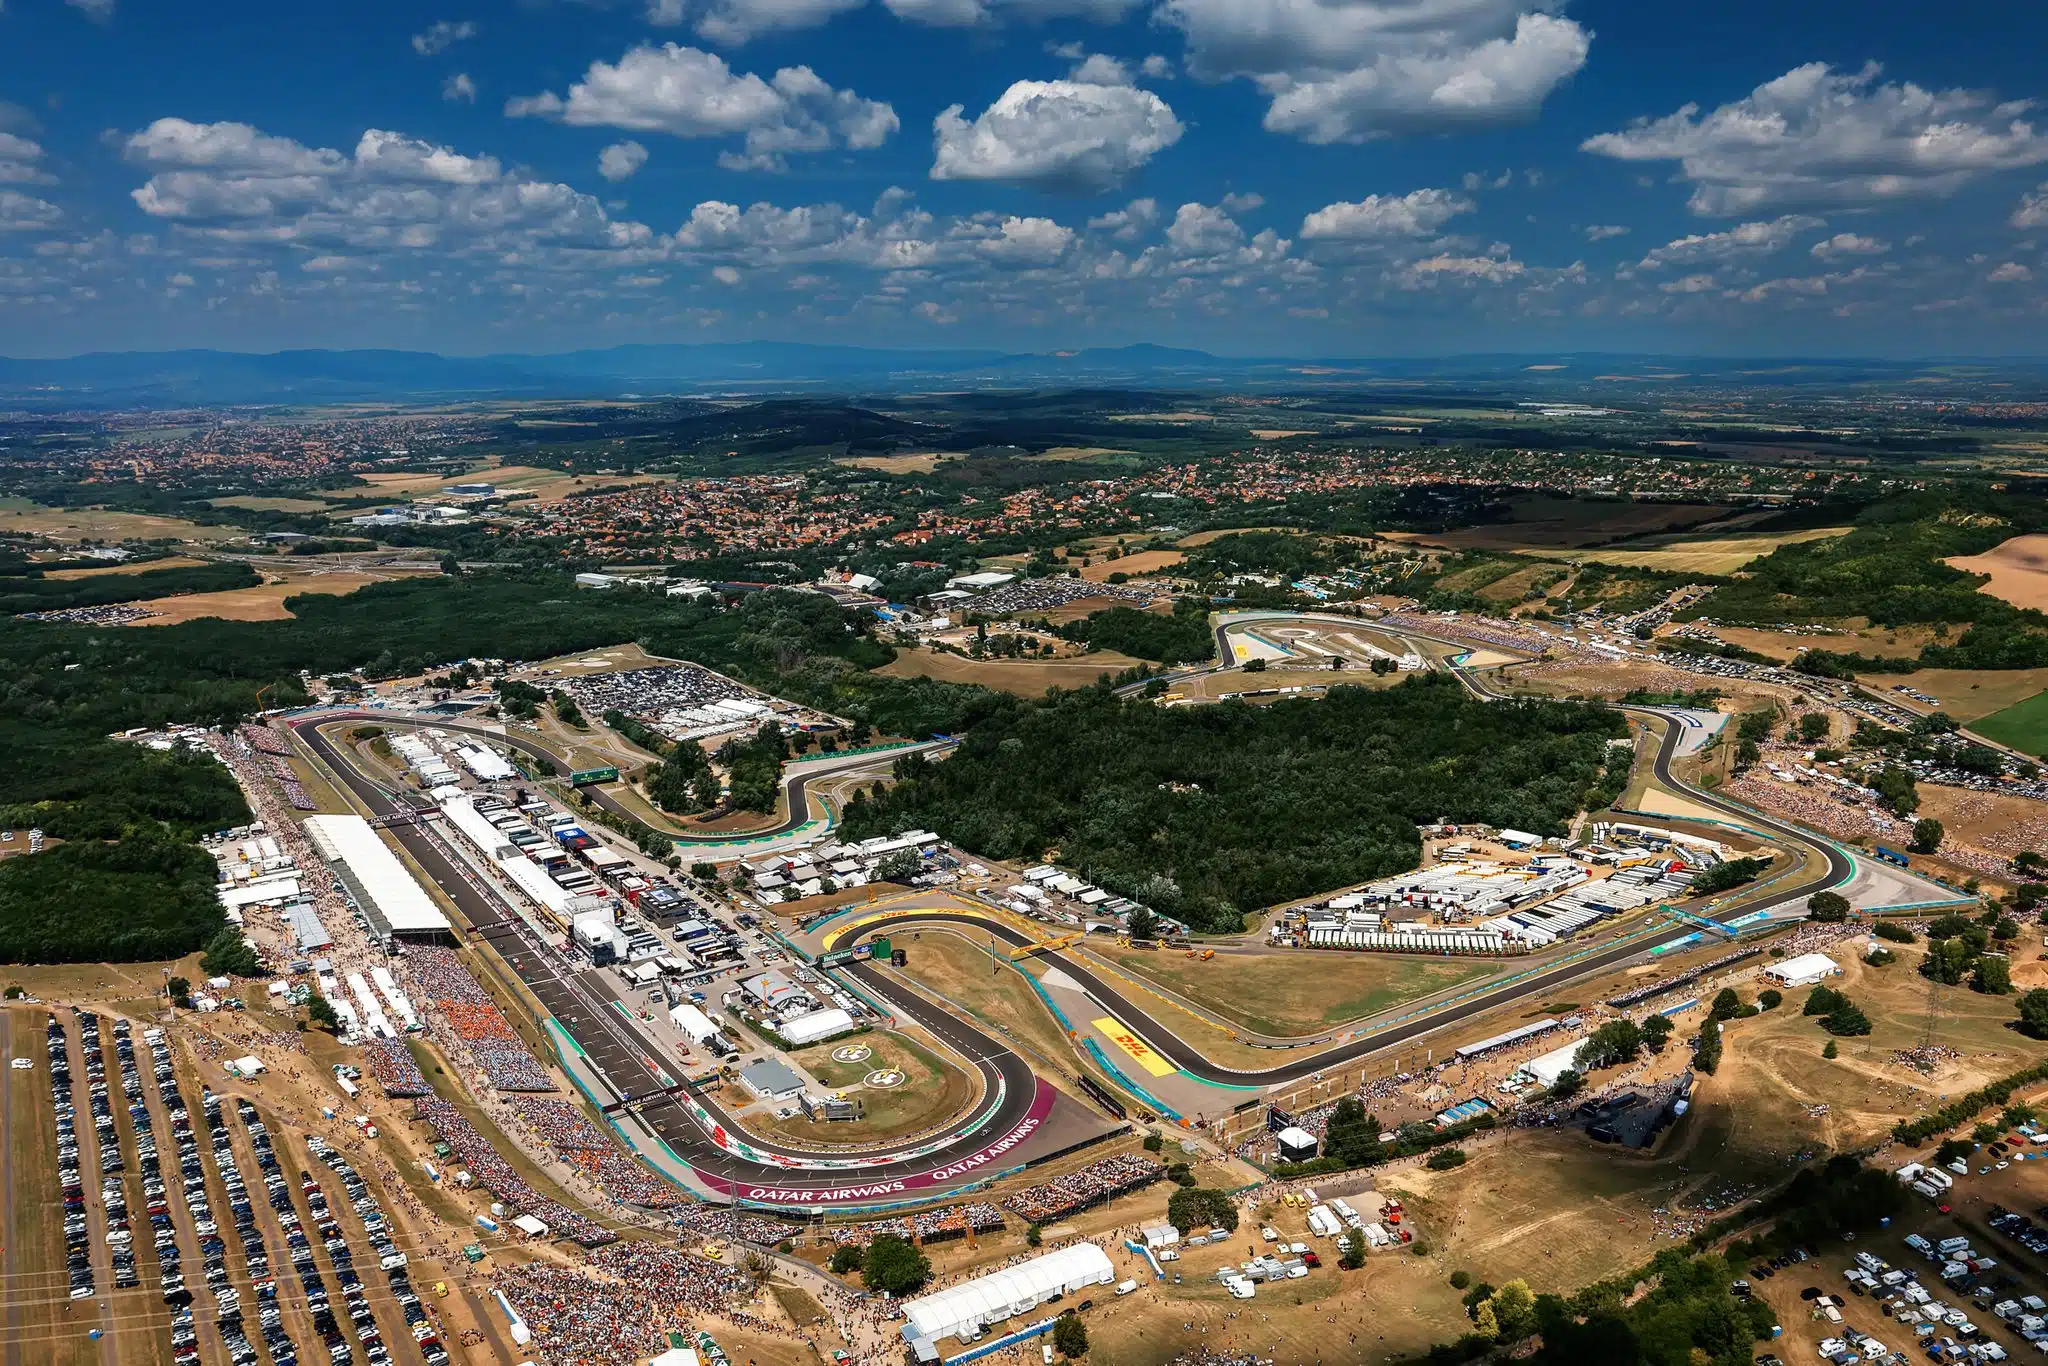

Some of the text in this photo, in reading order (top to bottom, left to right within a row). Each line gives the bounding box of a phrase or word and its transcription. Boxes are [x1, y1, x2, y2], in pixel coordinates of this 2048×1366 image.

[823, 951, 852, 962] Heineken
[1115, 1034, 1149, 1057] DHL
[621, 1092, 667, 1109] QATAR AIRWAYS
[933, 1118, 1039, 1180] QATAR AIRWAYS
[750, 1181, 905, 1201] QATAR AIRWAYS
